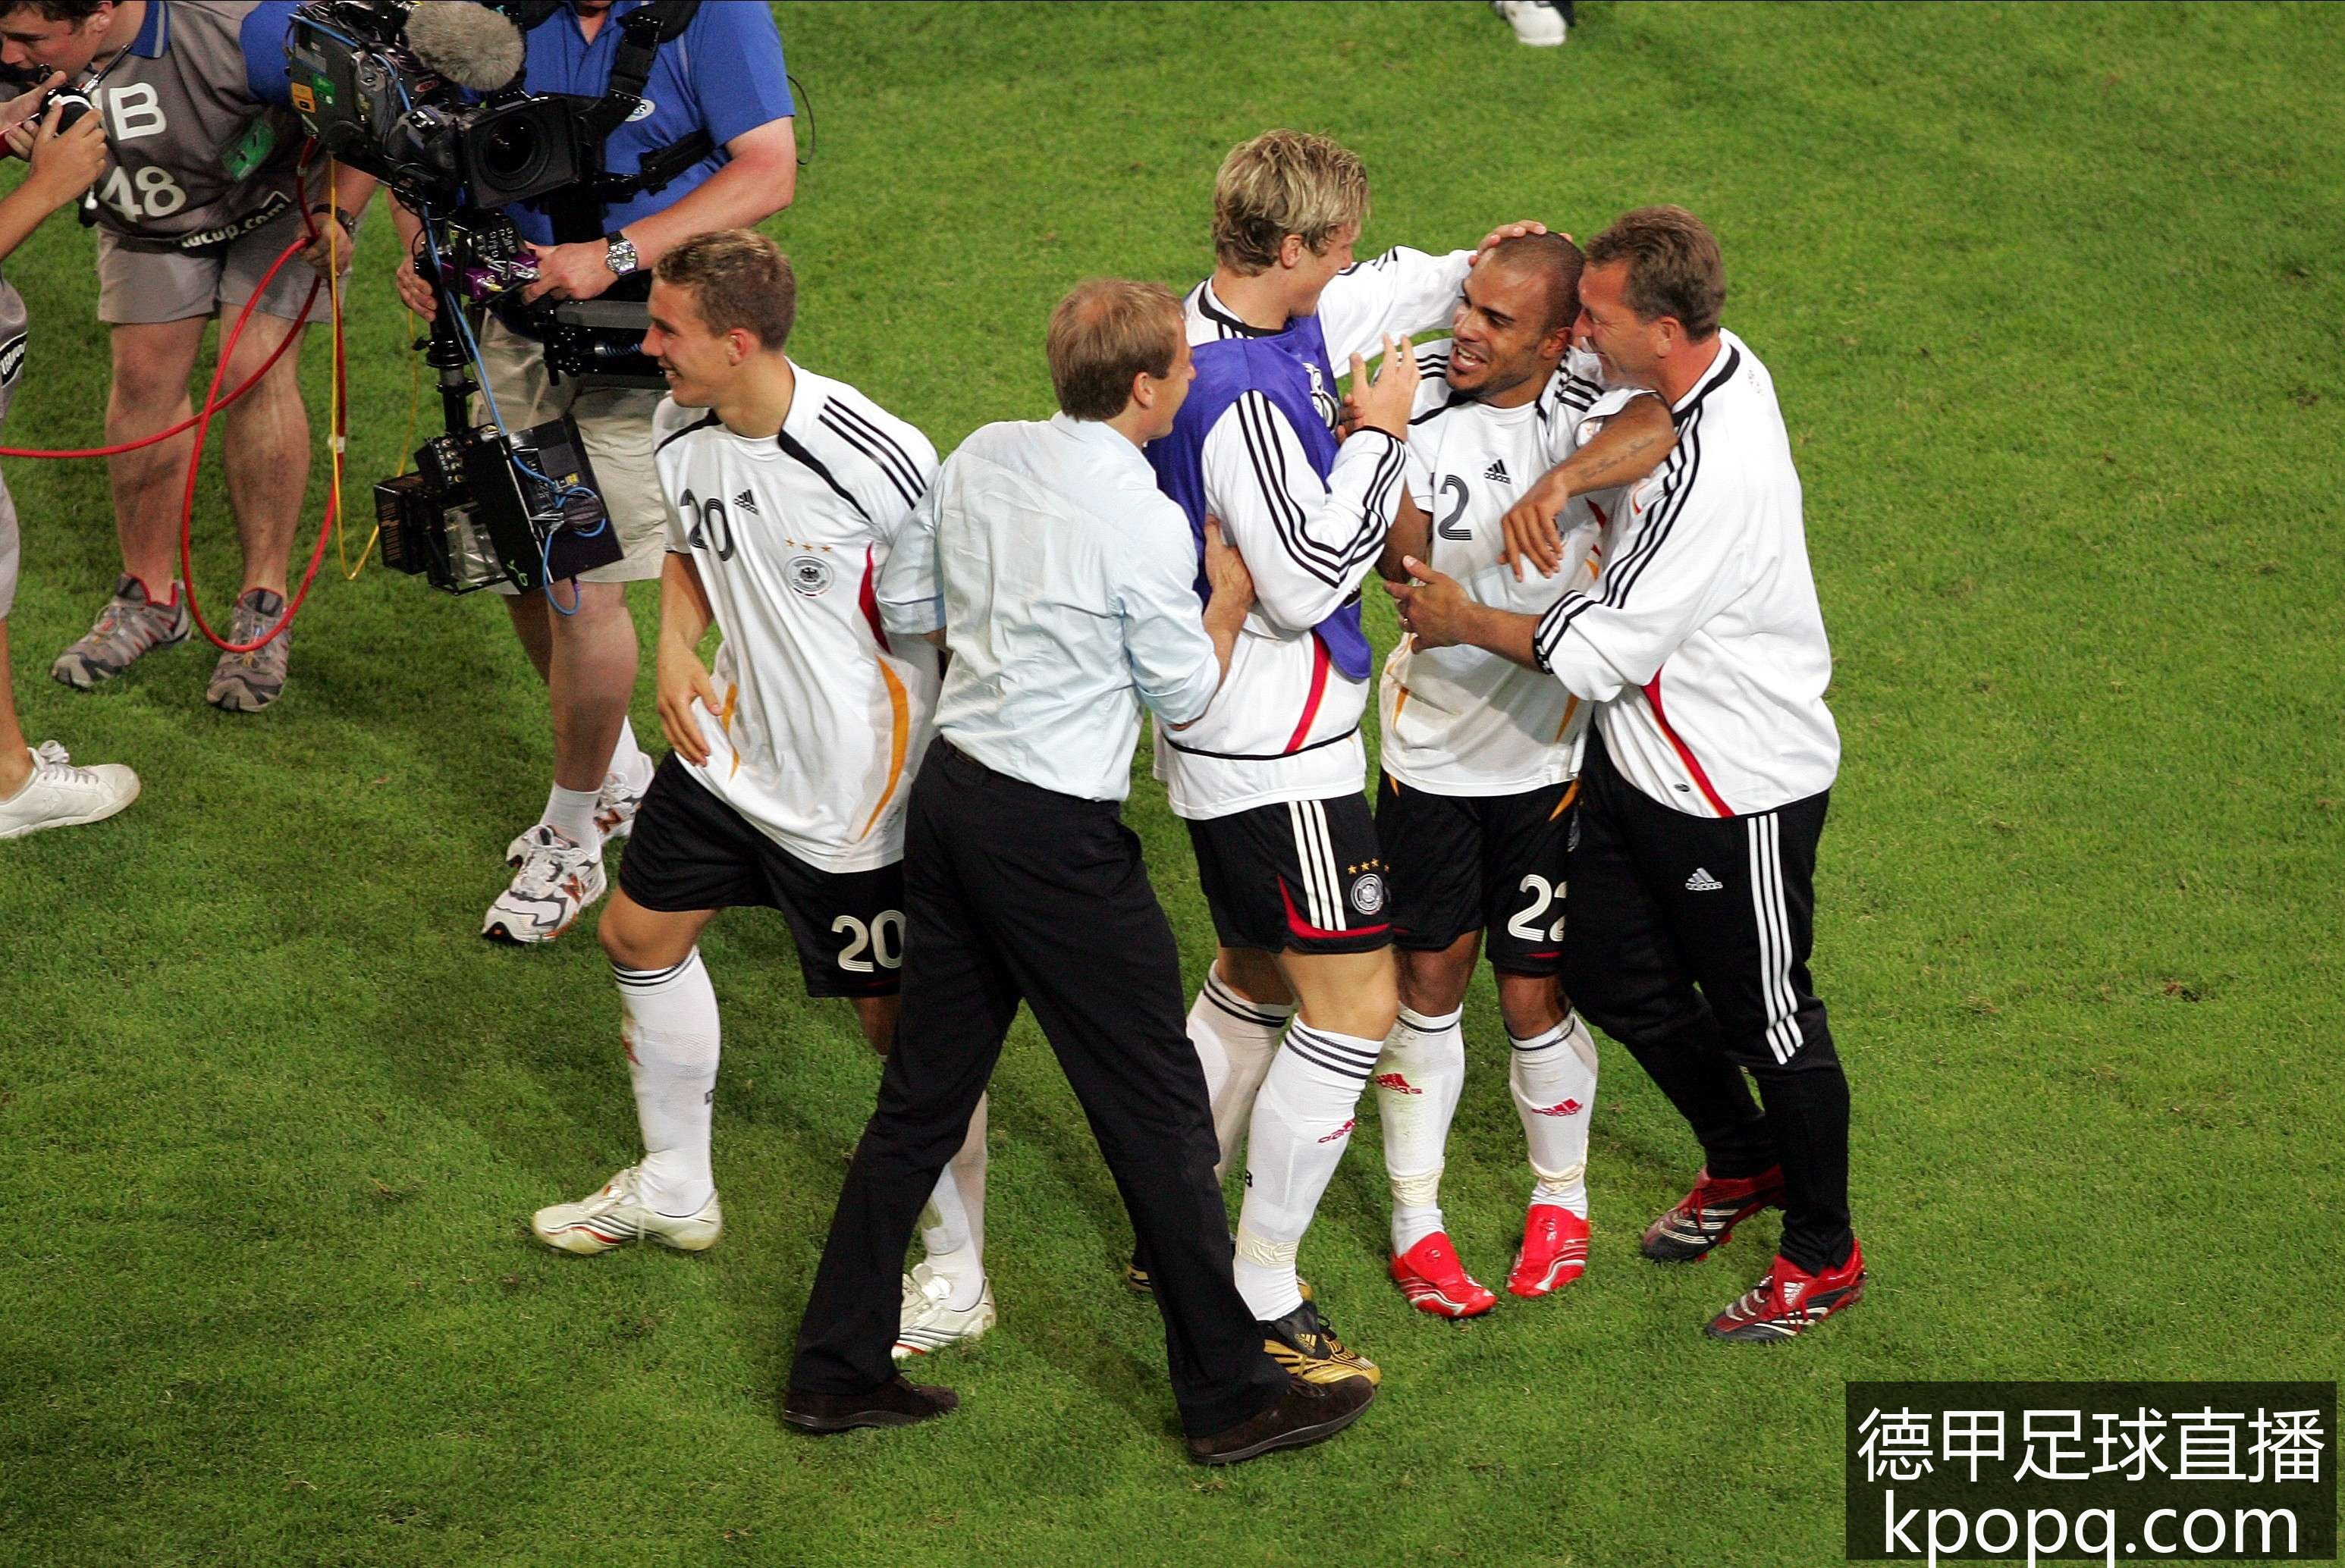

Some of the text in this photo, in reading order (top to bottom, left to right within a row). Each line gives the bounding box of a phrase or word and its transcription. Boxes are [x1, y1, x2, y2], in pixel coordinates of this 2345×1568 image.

[99, 165, 187, 222] 48
[680, 488, 734, 562] 20
[830, 909, 906, 973] 20
